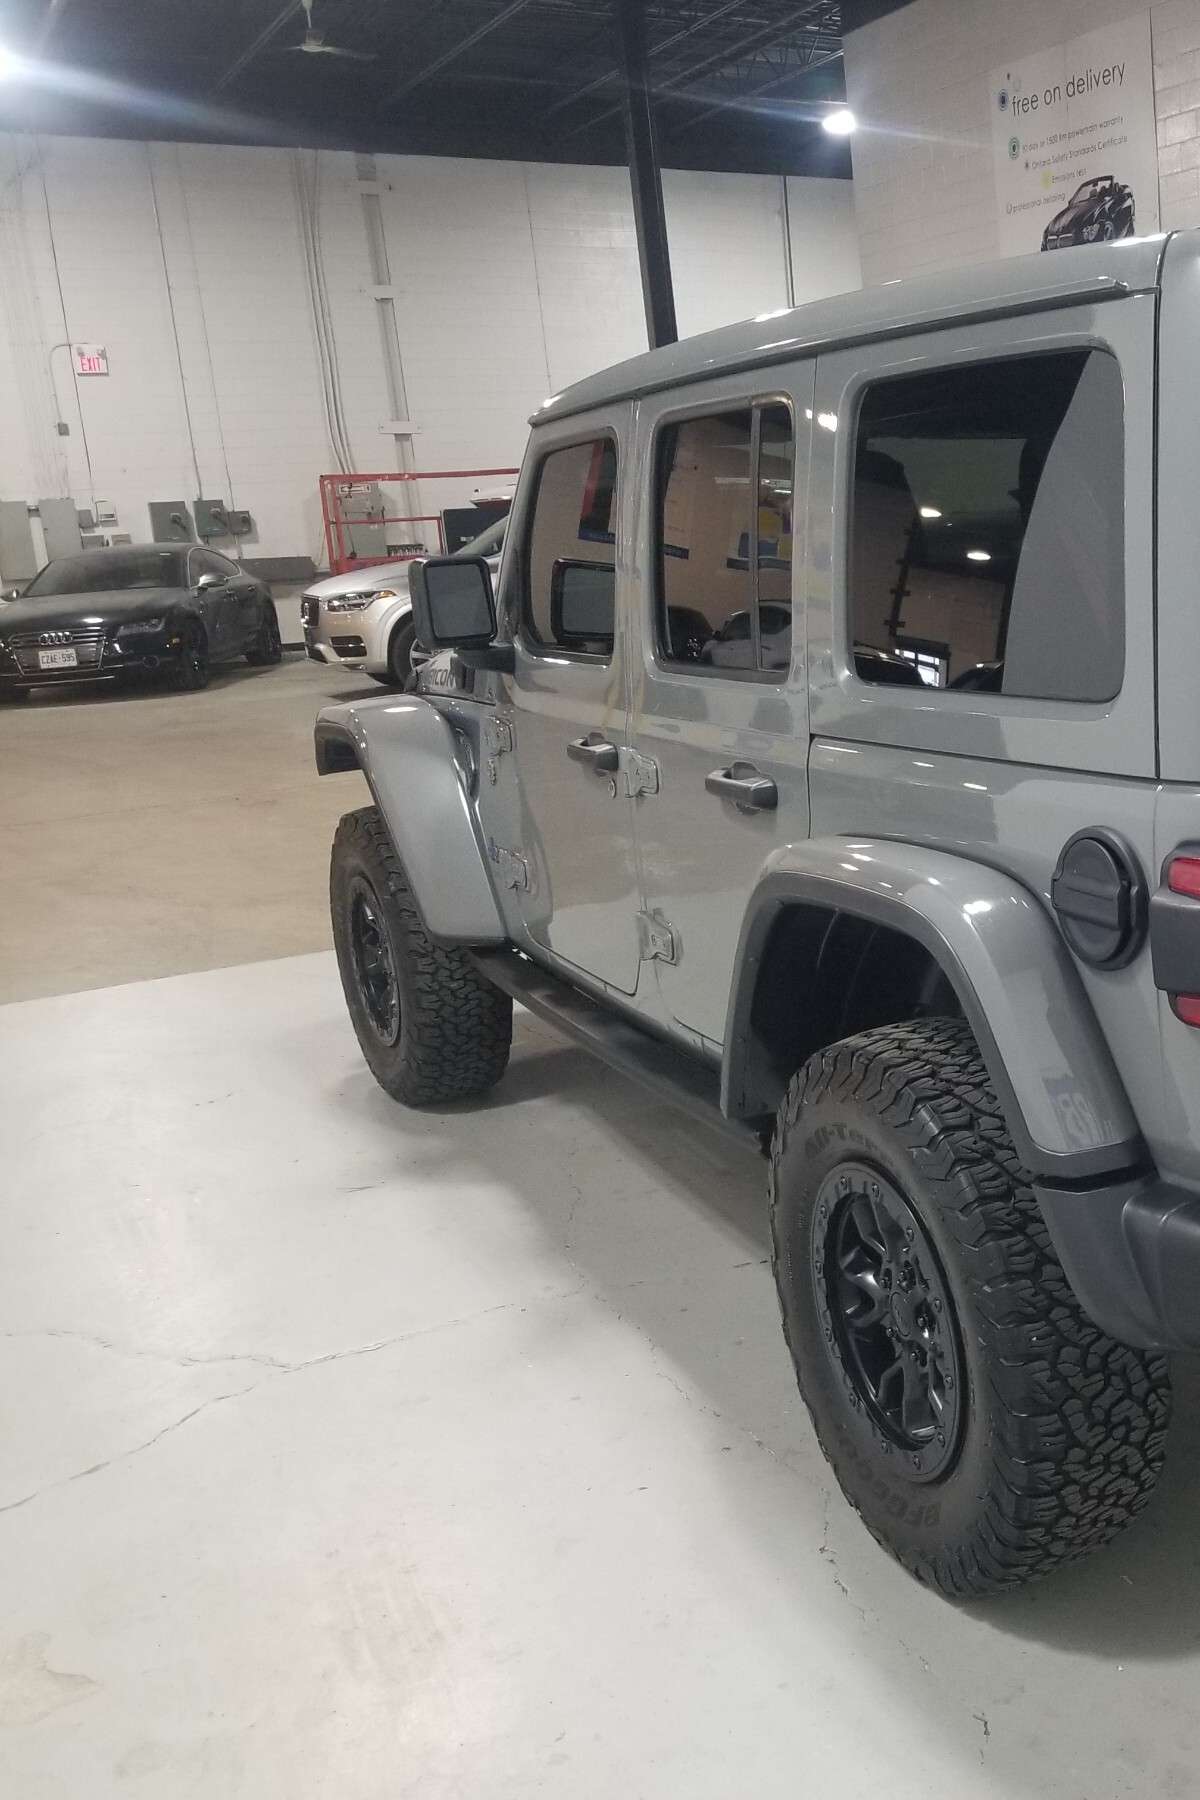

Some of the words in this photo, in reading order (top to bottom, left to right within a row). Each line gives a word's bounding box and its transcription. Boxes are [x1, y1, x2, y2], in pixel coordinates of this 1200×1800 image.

[1012, 94, 1039, 116] free
[1043, 85, 1061, 105] on
[1066, 62, 1125, 97] delivery
[80, 355, 101, 372] EXIT
